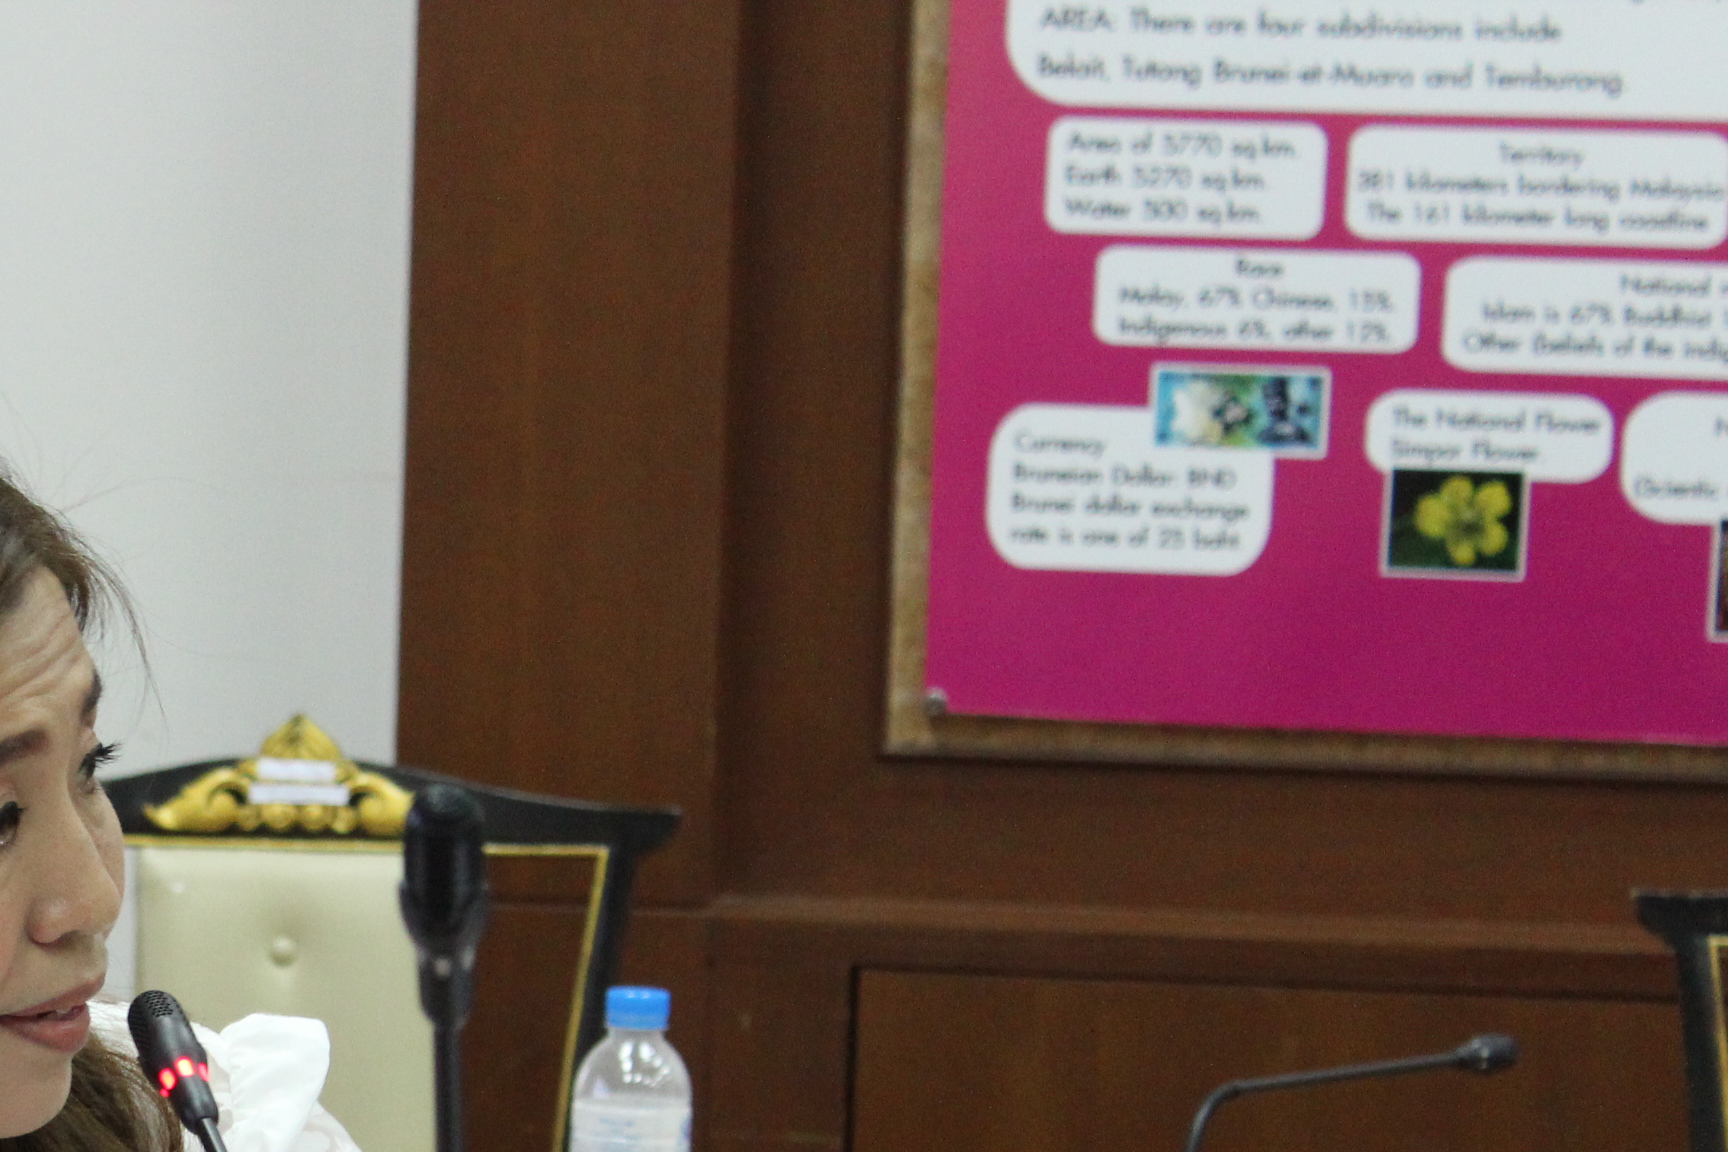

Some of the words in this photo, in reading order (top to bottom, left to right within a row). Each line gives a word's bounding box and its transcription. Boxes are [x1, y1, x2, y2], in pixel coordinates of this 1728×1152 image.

[1129, 6, 1194, 32] There
[1205, 16, 1247, 36] are
[1256, 8, 1306, 36] four
[1316, 10, 1462, 40] subdivisions
[1474, 12, 1563, 42] include
[1425, 60, 1473, 88] and
[1066, 131, 1121, 153] Area
[1132, 131, 1153, 153] of
[1162, 131, 1223, 156] 5770
[1498, 140, 1586, 170] Territory
[1065, 163, 1122, 188] Earth
[1404, 168, 1510, 194] kilometers
[1518, 172, 1620, 204] bordering
[1630, 173, 1728, 205] Malaysia
[1063, 198, 1132, 221] Water
[1142, 198, 1189, 223] 500
[1367, 199, 1404, 223] The
[1413, 200, 1451, 224] 161
[1461, 200, 1556, 226] kilometer
[1562, 202, 1611, 233] long
[1619, 205, 1710, 231] coastline
[1235, 257, 1286, 278] Race
[1620, 272, 1713, 298] National
[1482, 299, 1536, 324] Islam
[1543, 301, 1561, 324] is
[1624, 301, 1713, 328] Buddhist
[1118, 314, 1227, 344] Indigenous
[1282, 317, 1335, 341] other
[1461, 327, 1522, 355] Other
[1612, 333, 1637, 355] of
[1642, 332, 1674, 356] the
[1392, 405, 1428, 429] The
[1435, 406, 1526, 433] National
[1532, 411, 1601, 436] Flower
[1013, 431, 1106, 461] Currency
[1391, 438, 1462, 467] Simpor
[1012, 460, 1103, 485] Bruneian
[1186, 466, 1239, 491] BND
[1011, 489, 1075, 514] Brunei
[1084, 490, 1141, 515] dollar
[1150, 496, 1250, 522] exchange
[1010, 525, 1050, 545] rate
[1058, 524, 1075, 546] is
[1080, 529, 1121, 548] one
[1128, 525, 1151, 549] of
[1192, 526, 1241, 551] baht
